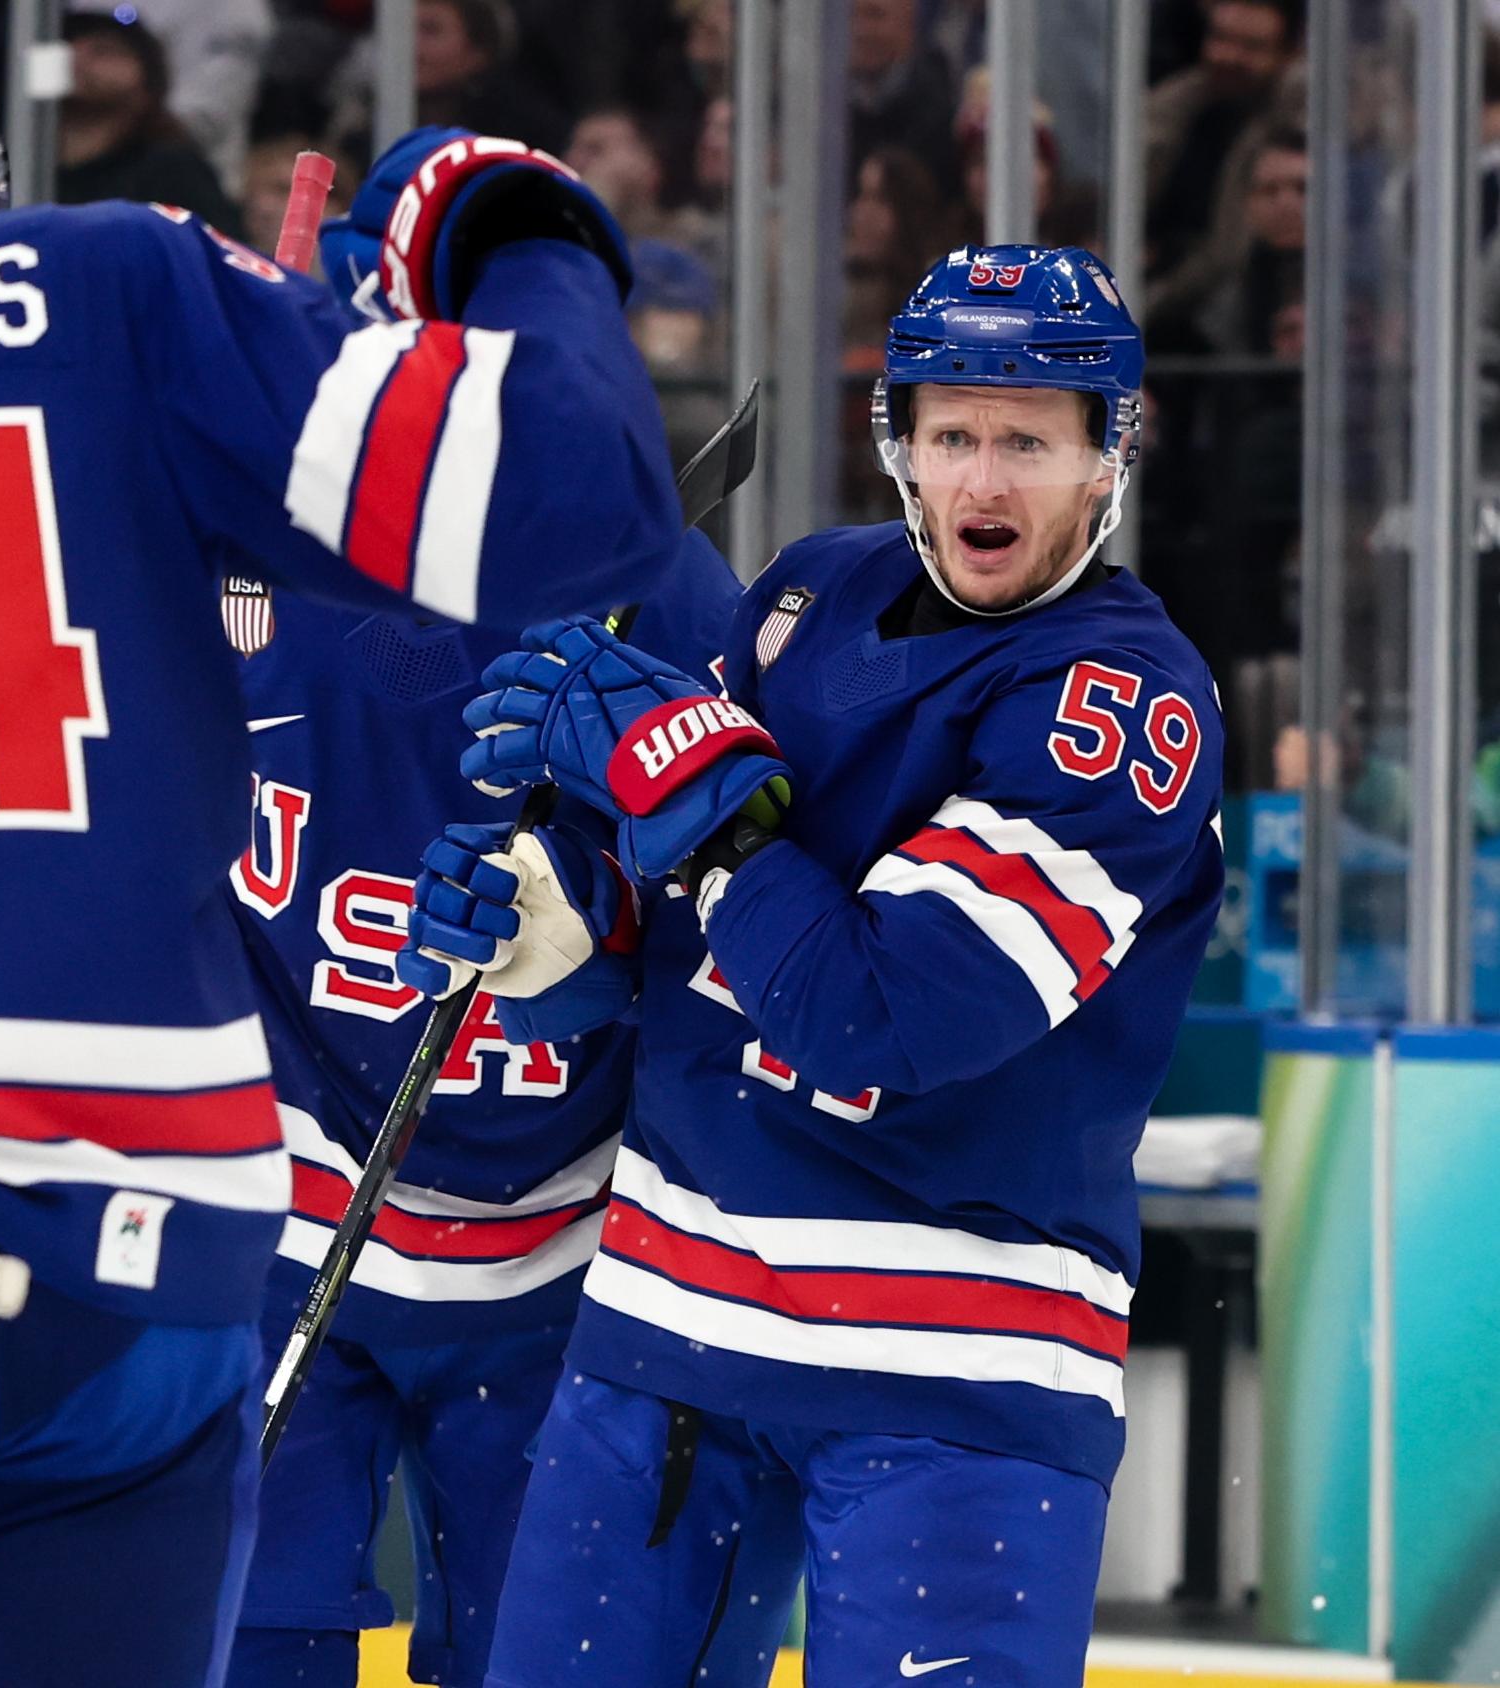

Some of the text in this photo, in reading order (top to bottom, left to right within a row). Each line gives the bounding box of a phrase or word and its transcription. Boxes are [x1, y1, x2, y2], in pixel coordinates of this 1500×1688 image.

[968, 262, 1028, 288] 59
[952, 314, 1028, 326] MILANO CORTINA
[980, 322, 998, 330] 2026
[229, 576, 264, 594] USA
[778, 593, 804, 612] USA
[631, 700, 772, 779] RIOR
[1047, 660, 1201, 815] 59
